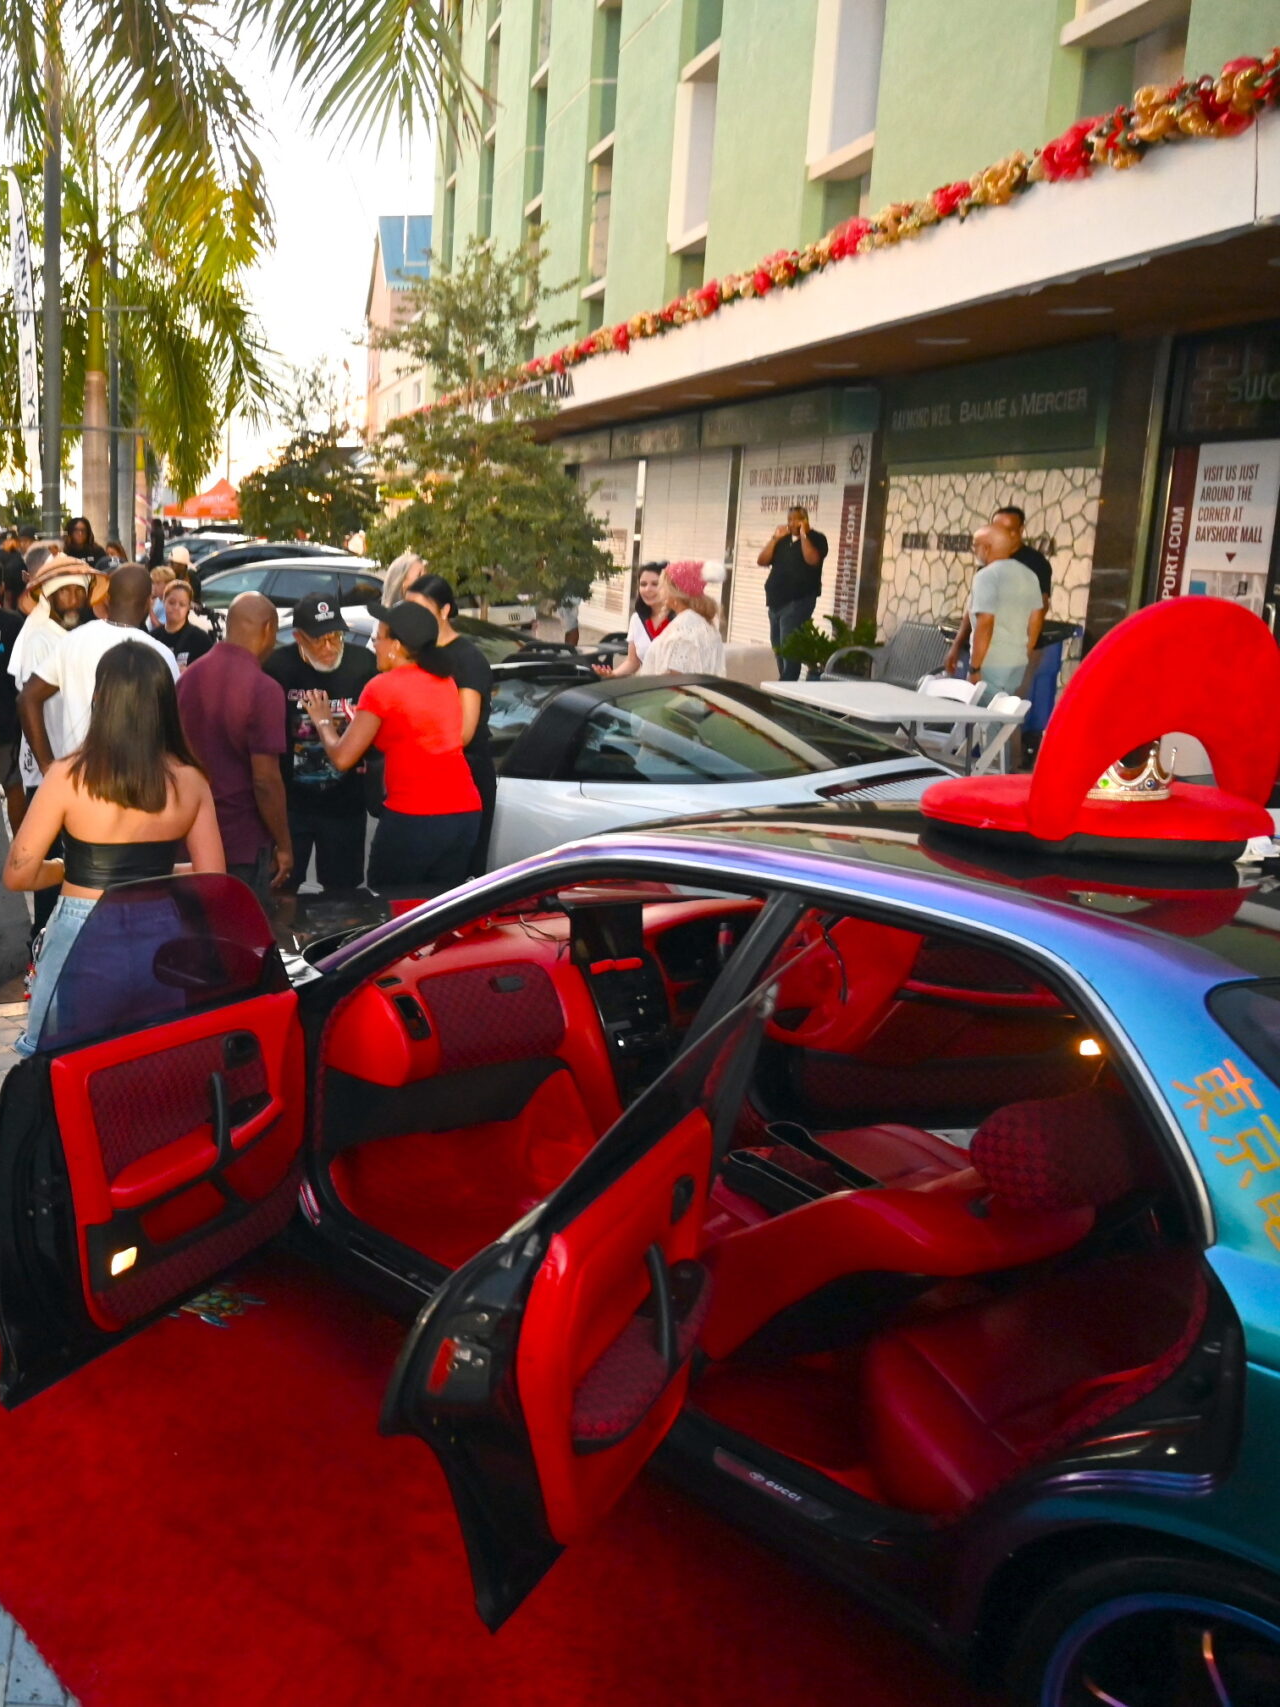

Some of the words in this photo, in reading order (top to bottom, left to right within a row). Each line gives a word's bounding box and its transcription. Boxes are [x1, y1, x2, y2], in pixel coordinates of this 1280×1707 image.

[959, 398, 1006, 423] BAUME
[1010, 403, 1017, 418] &
[1021, 387, 1087, 416] MERCIER
[759, 468, 772, 485] FIND
[773, 468, 782, 487] US
[793, 465, 805, 485] THE
[1203, 465, 1224, 481] VISIT
[1225, 465, 1236, 481] US
[1239, 464, 1260, 480] JUST
[1200, 486, 1235, 502] AROUND
[1237, 485, 1253, 501] THE
[1198, 507, 1230, 522] CORNER
[1232, 507, 1243, 522] AT
[1195, 526, 1238, 543] BAYSHORE
[1240, 526, 1262, 543] MALL
[765, 1480, 802, 1501] GUCCI
